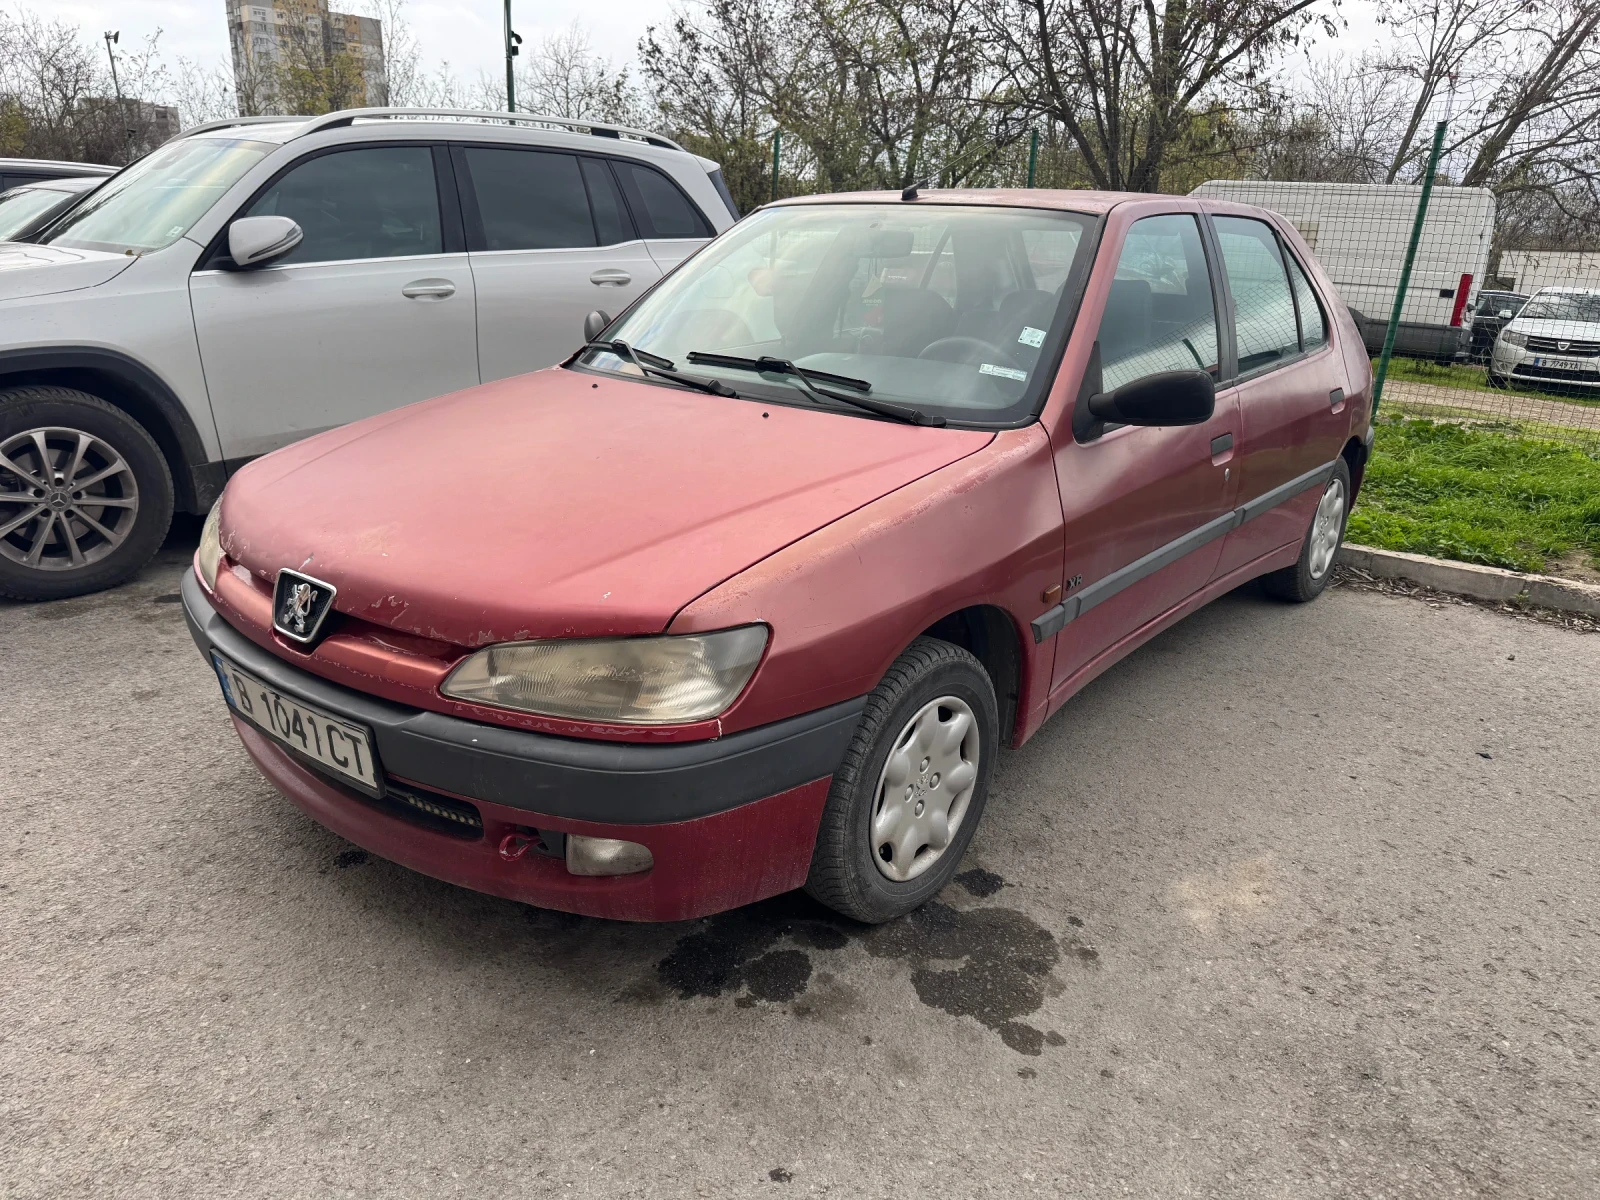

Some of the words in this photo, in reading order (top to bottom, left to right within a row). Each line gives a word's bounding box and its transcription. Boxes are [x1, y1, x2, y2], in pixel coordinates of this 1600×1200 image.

[232, 672, 253, 714] B
[260, 691, 322, 757] 1041
[326, 724, 364, 776] CT
